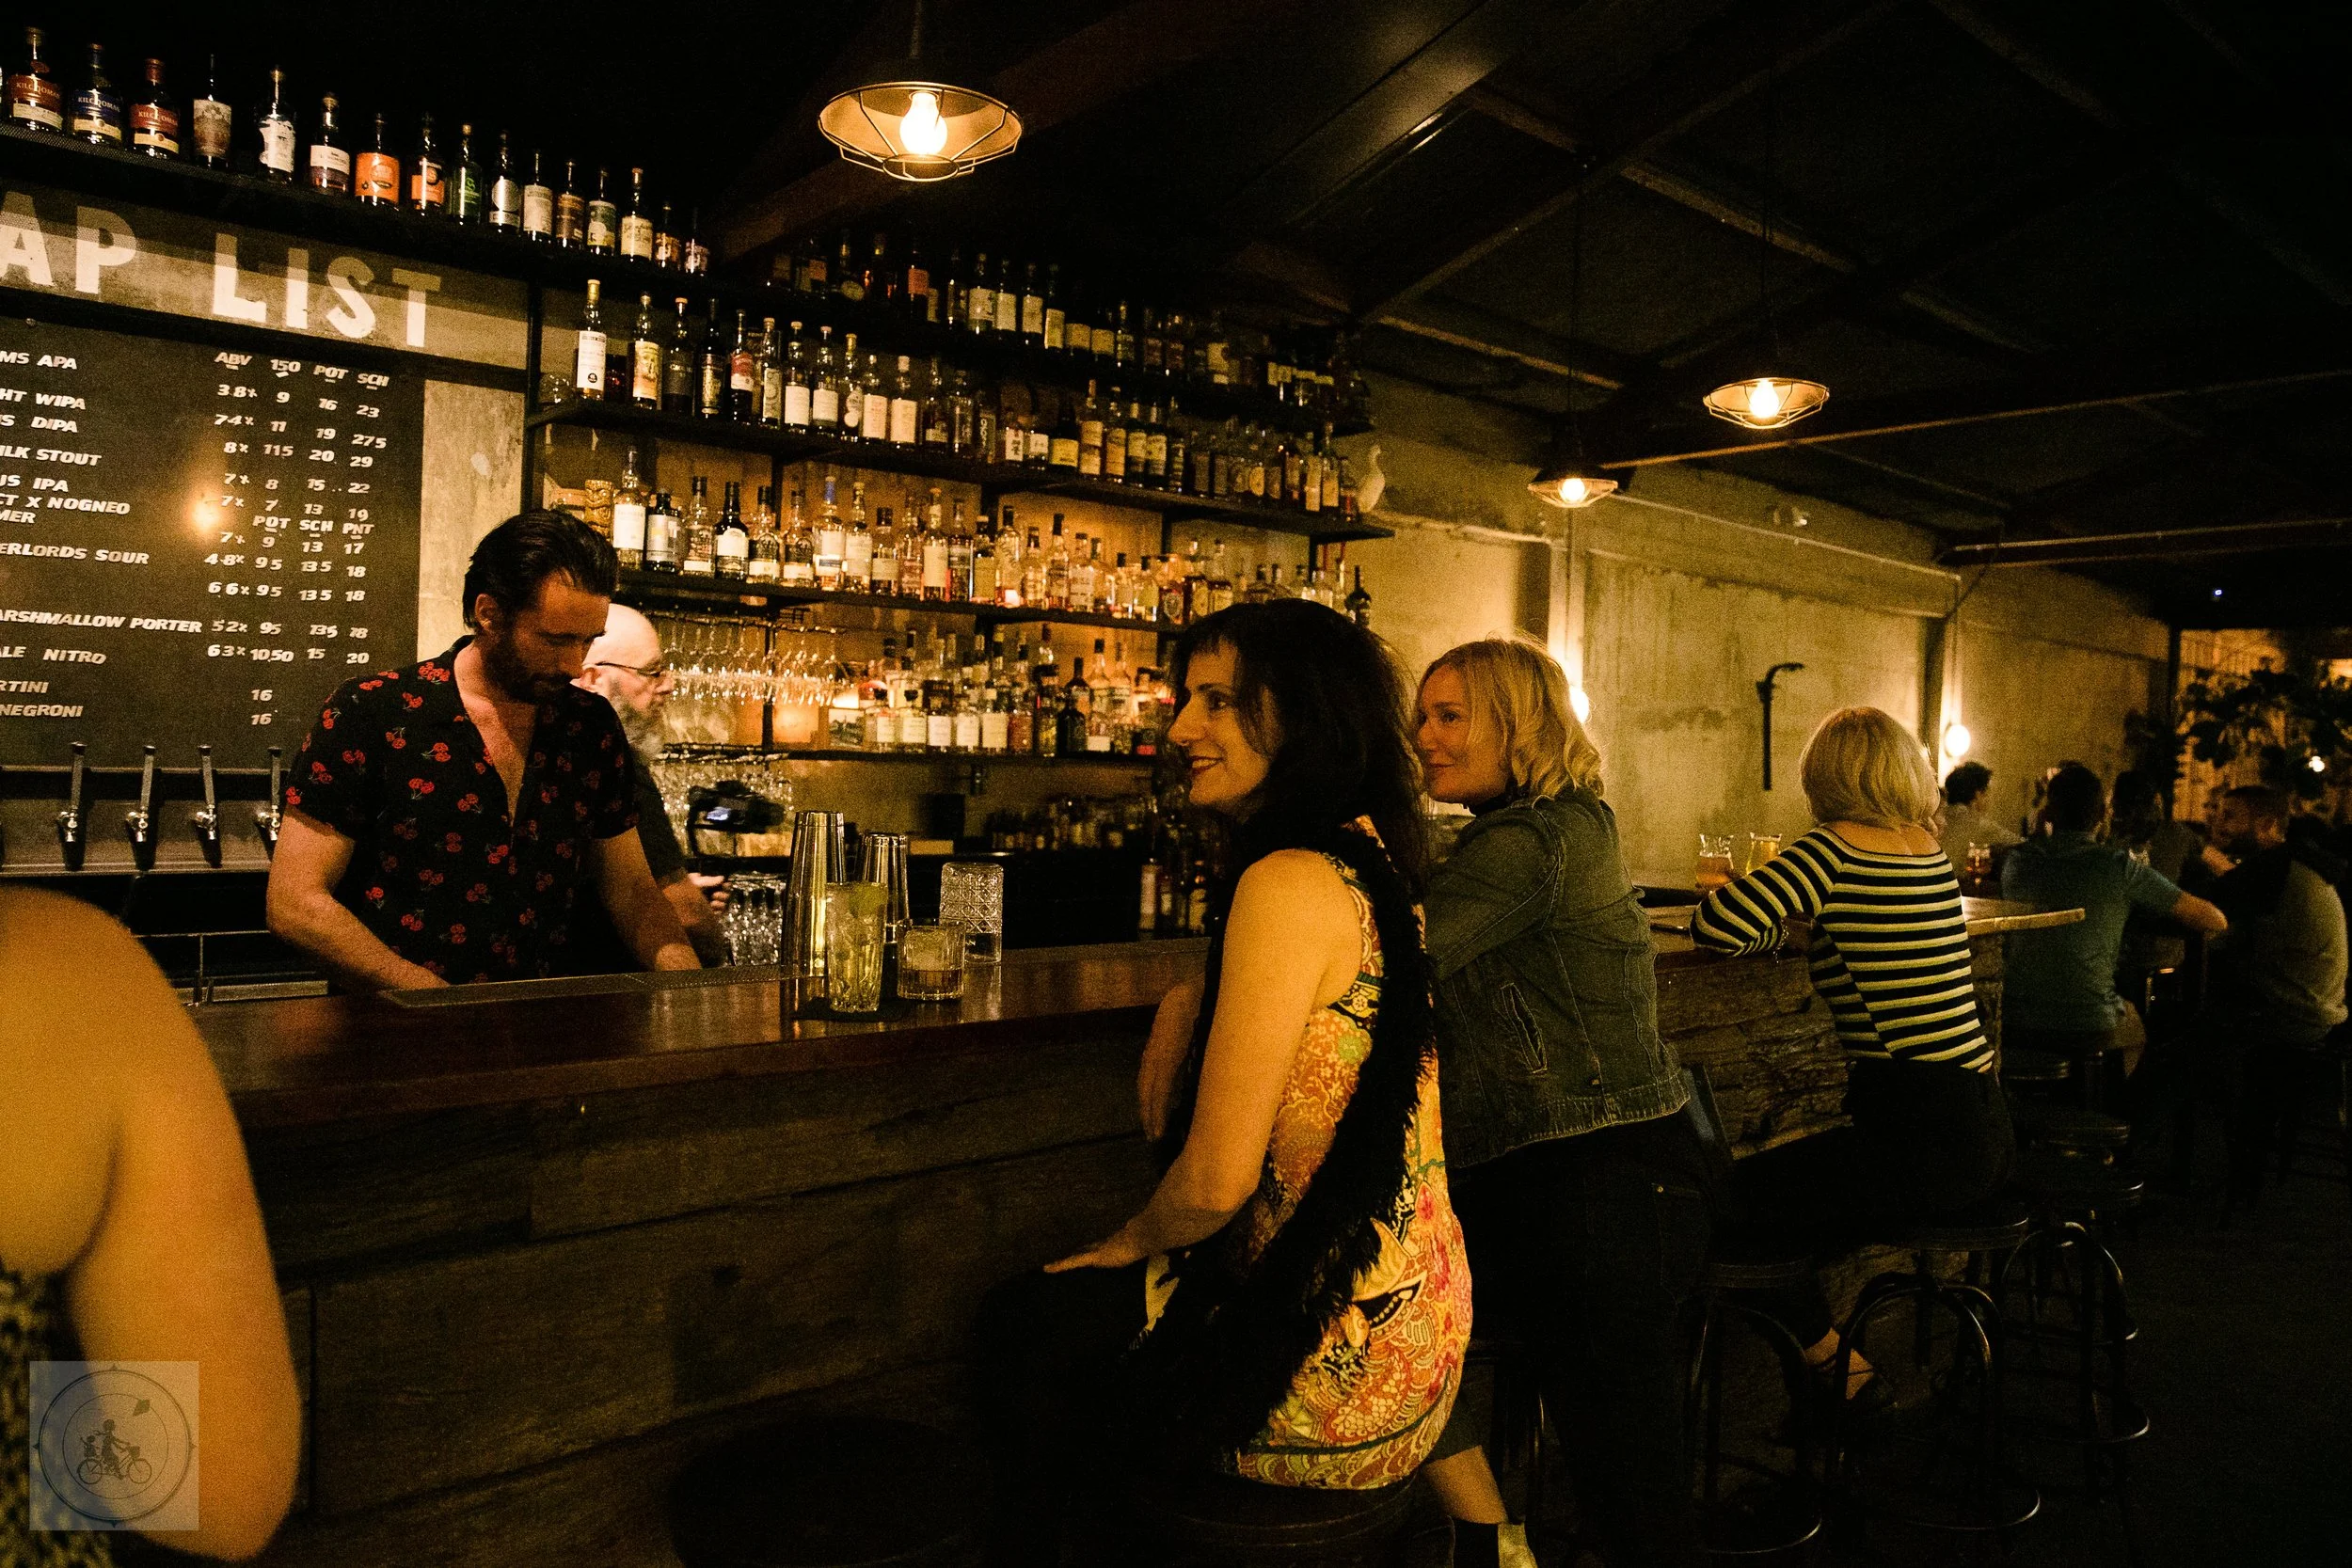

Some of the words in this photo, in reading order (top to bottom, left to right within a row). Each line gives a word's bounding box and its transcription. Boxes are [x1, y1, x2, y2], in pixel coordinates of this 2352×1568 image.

[0, 192, 136, 294] AP
[213, 230, 442, 348] LIST
[37, 355, 76, 369] APA
[277, 392, 290, 403] 9
[319, 399, 338, 410] 16
[357, 405, 379, 418] 23
[215, 352, 252, 367] ABV
[313, 365, 348, 381] POT
[358, 373, 389, 388] SCH
[36, 393, 85, 409] WIPA
[271, 421, 286, 432] 11
[317, 428, 336, 439] 19
[31, 417, 77, 433] DIPA
[224, 442, 247, 453] 8%
[264, 444, 293, 456] 115
[310, 450, 334, 461] 20
[350, 456, 373, 467] 29
[37, 449, 102, 466] STOUT
[225, 473, 249, 484] 7%
[265, 480, 278, 489] 8
[309, 479, 325, 491] 15
[348, 483, 370, 493] 22
[33, 478, 68, 492] IPA
[220, 496, 243, 506] 7%
[266, 499, 278, 511] 7
[305, 504, 323, 515] 13
[349, 509, 368, 521] 19
[25, 497, 41, 508] X
[218, 531, 245, 544] 7%
[262, 537, 275, 547] 9
[303, 542, 323, 552] 13
[344, 543, 364, 554] 17
[253, 515, 291, 531] POT
[300, 520, 333, 531] SCH
[342, 523, 373, 534] PNT
[95, 549, 149, 563] SOUR
[347, 566, 366, 577] 18
[346, 591, 365, 601] 18
[130, 618, 202, 632] PORTER
[43, 649, 106, 664] NITRO
[308, 648, 325, 658] 15
[347, 653, 369, 663] 20
[252, 689, 272, 701] 16
[0, 705, 83, 717] NEGRONI
[252, 713, 272, 725] 16
